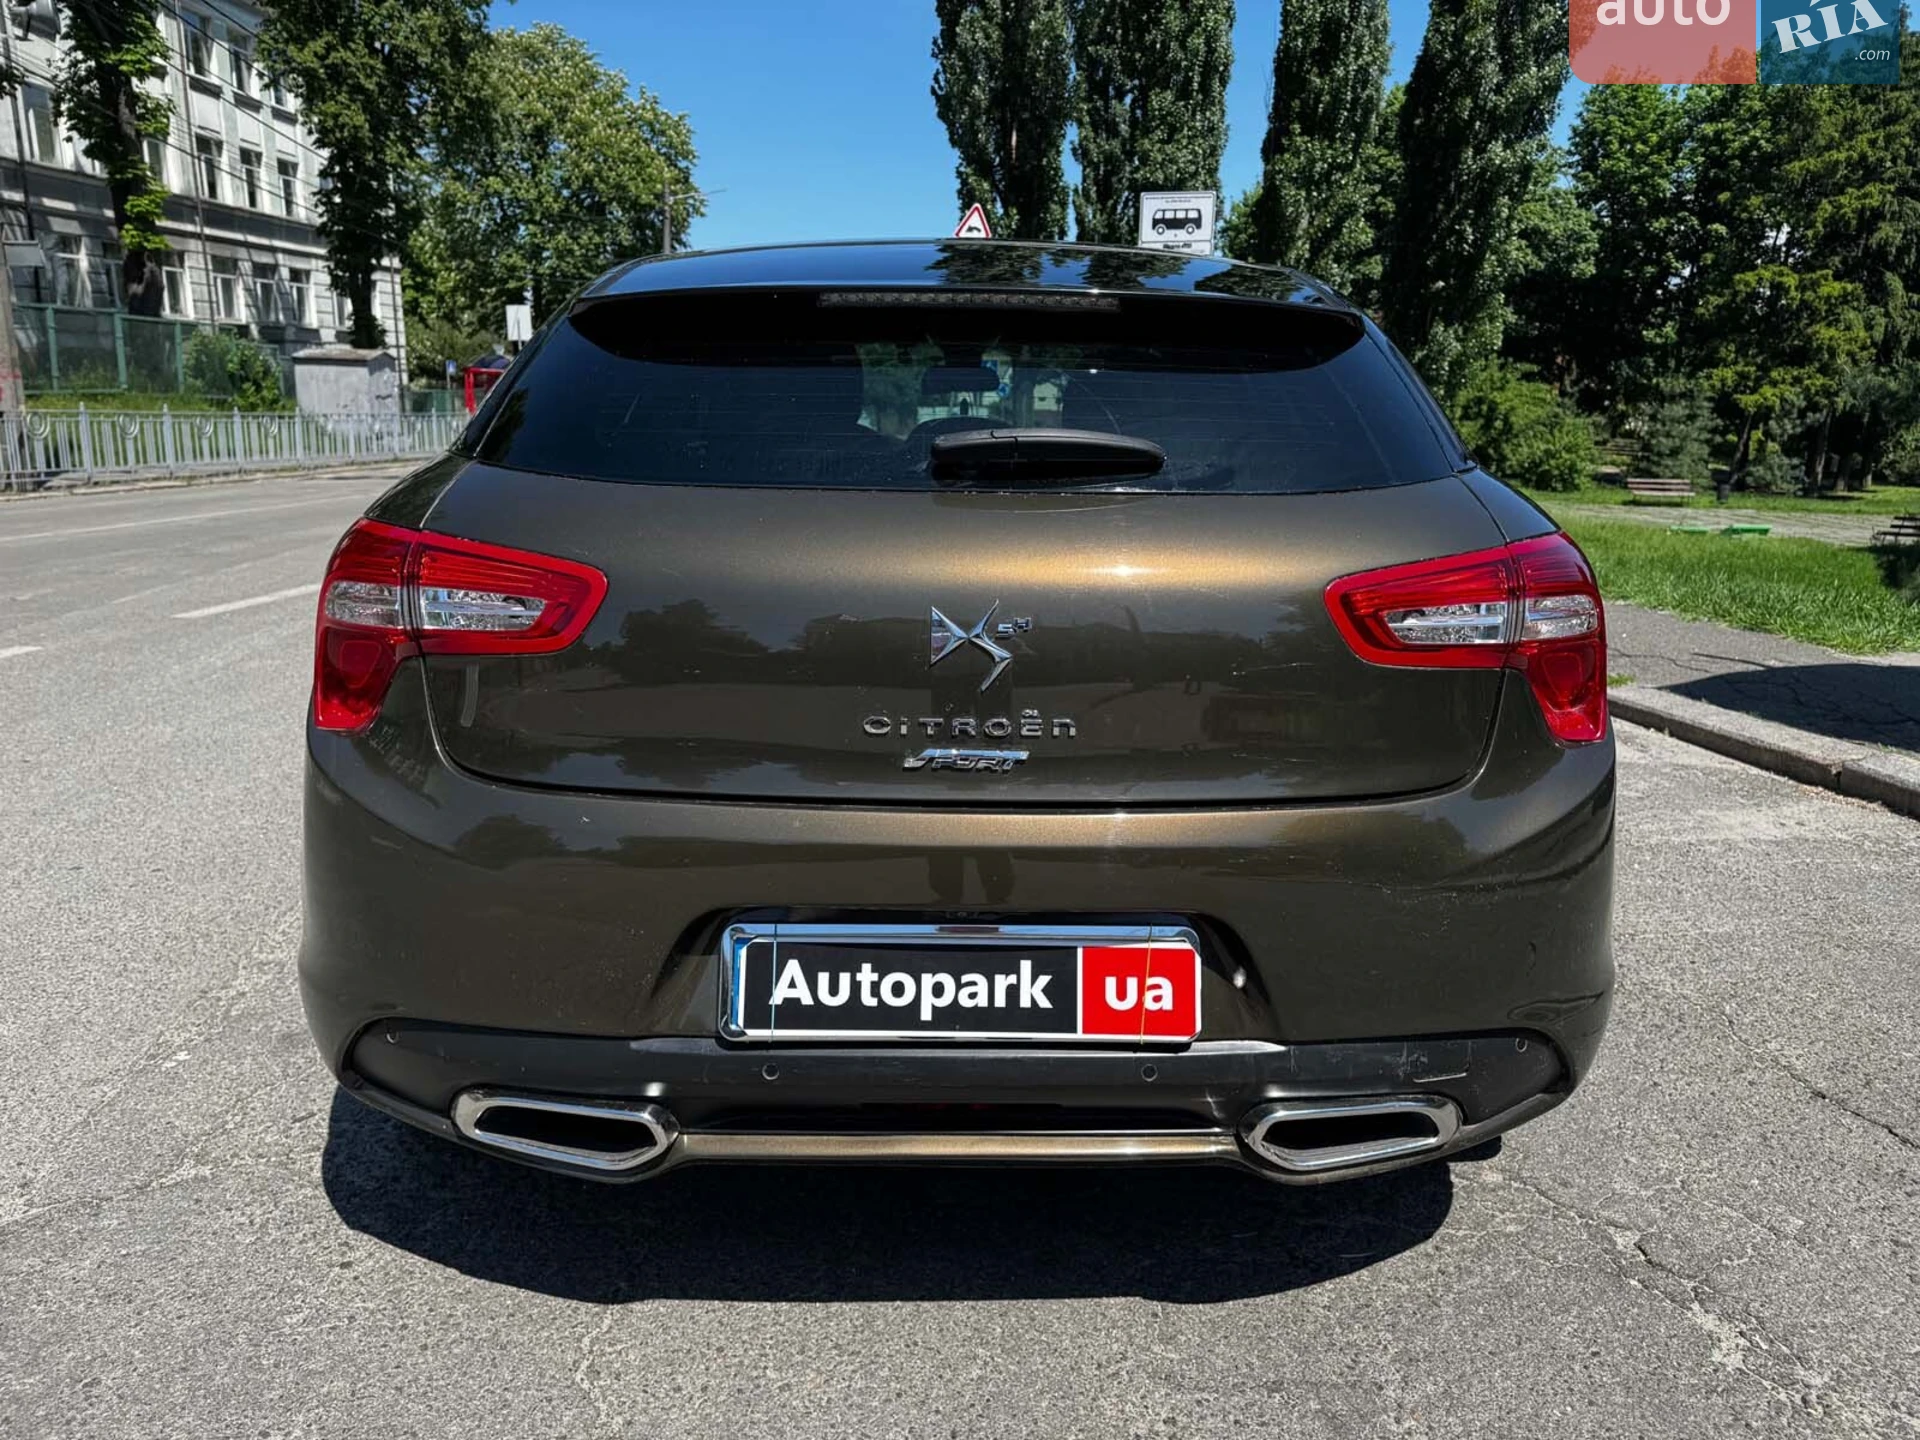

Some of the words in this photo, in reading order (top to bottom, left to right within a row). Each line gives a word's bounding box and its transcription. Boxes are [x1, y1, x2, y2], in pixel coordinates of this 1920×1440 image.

[903, 748, 1030, 770] SPORT
[769, 959, 1053, 1021] Autopark
[1104, 976, 1173, 1011] ua
